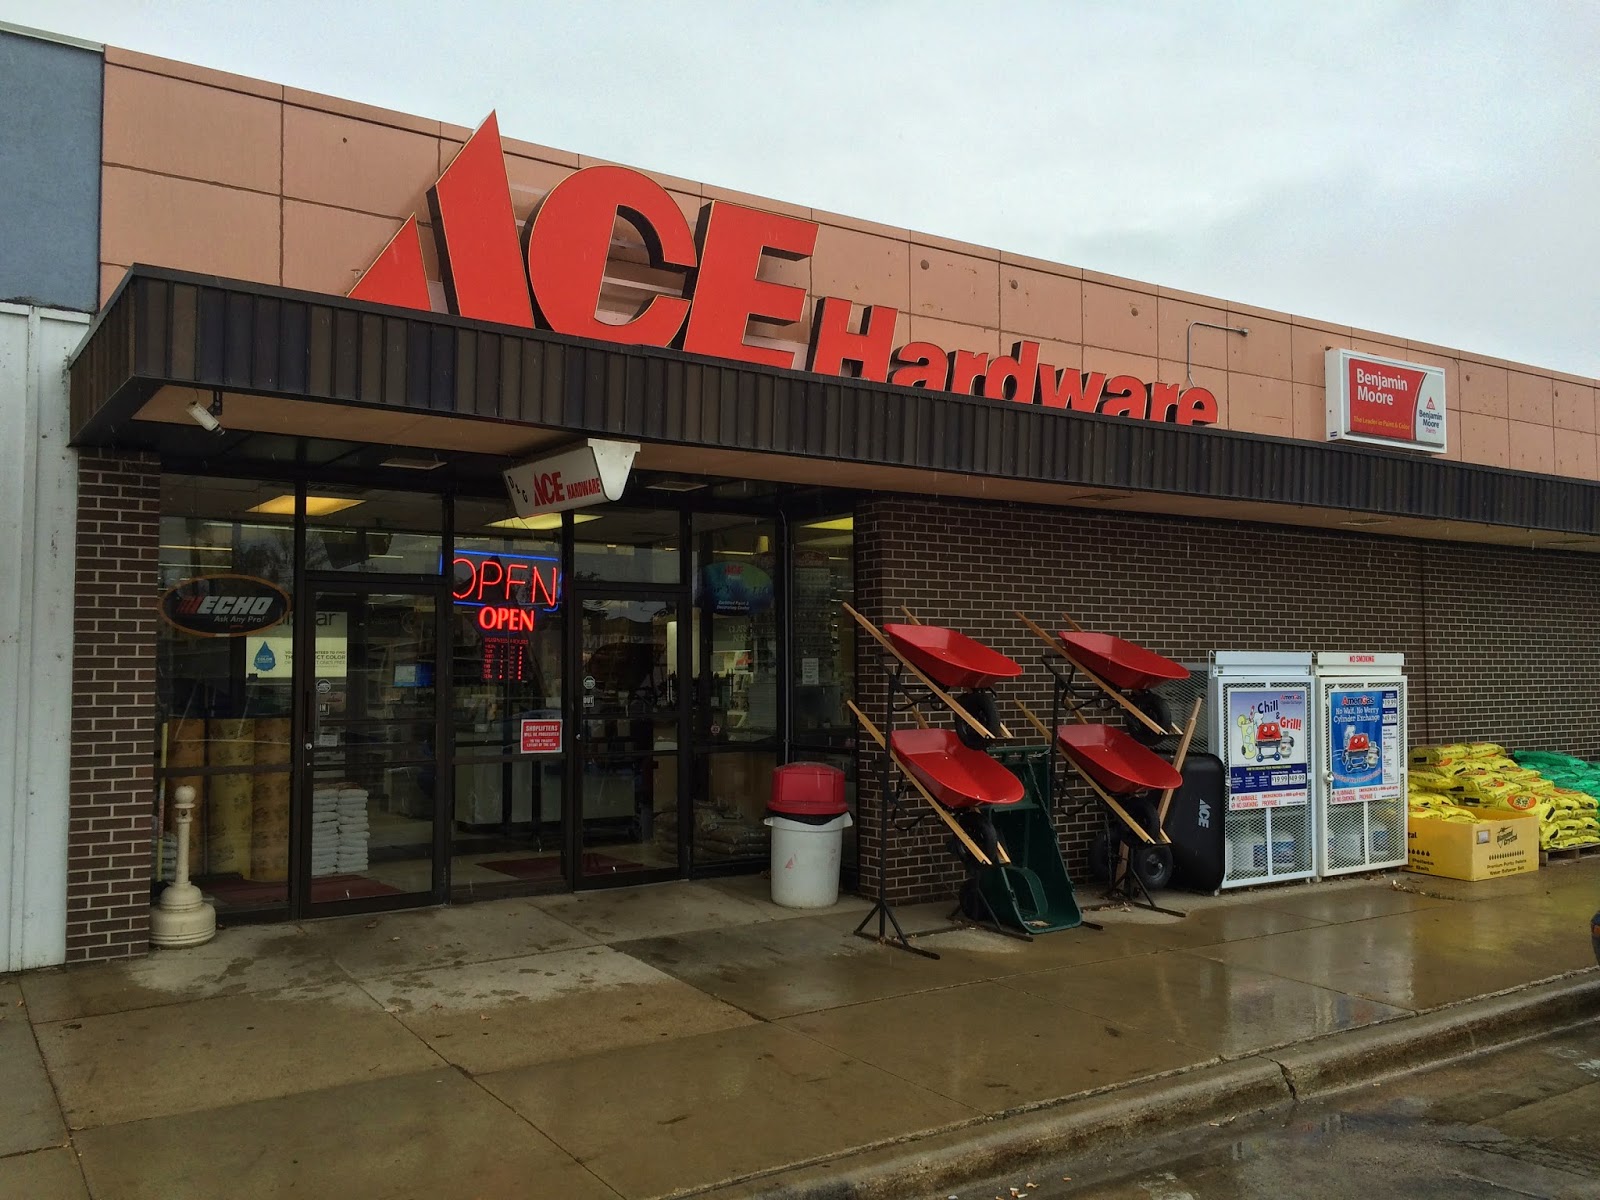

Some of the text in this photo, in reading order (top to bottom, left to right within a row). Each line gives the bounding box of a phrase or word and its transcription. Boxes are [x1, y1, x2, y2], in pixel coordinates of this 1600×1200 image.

[346, 109, 1219, 427] ACE Hardware
[1356, 368, 1408, 391] Benjamin
[1357, 386, 1394, 405] Moore
[1418, 410, 1442, 421] Benjamin
[1363, 417, 1377, 425] Leader
[1382, 419, 1394, 428] Paint
[1398, 422, 1410, 430] Color
[1422, 419, 1439, 428] Moore
[533, 471, 601, 507] ACE HARDWARE
[453, 557, 557, 607] OPEN
[196, 596, 274, 615] ECHO
[230, 616, 246, 624] Any
[478, 606, 535, 631] OPEN
[1257, 699, 1279, 714] Chill
[1341, 695, 1375, 706] AmeriGas
[1275, 711, 1280, 720] &
[1356, 706, 1363, 714] No
[1363, 706, 1379, 715] Worry
[1280, 716, 1302, 731] Grill!
[1333, 714, 1380, 724] Cylinder Exchange
[1198, 798, 1211, 828] ACE
